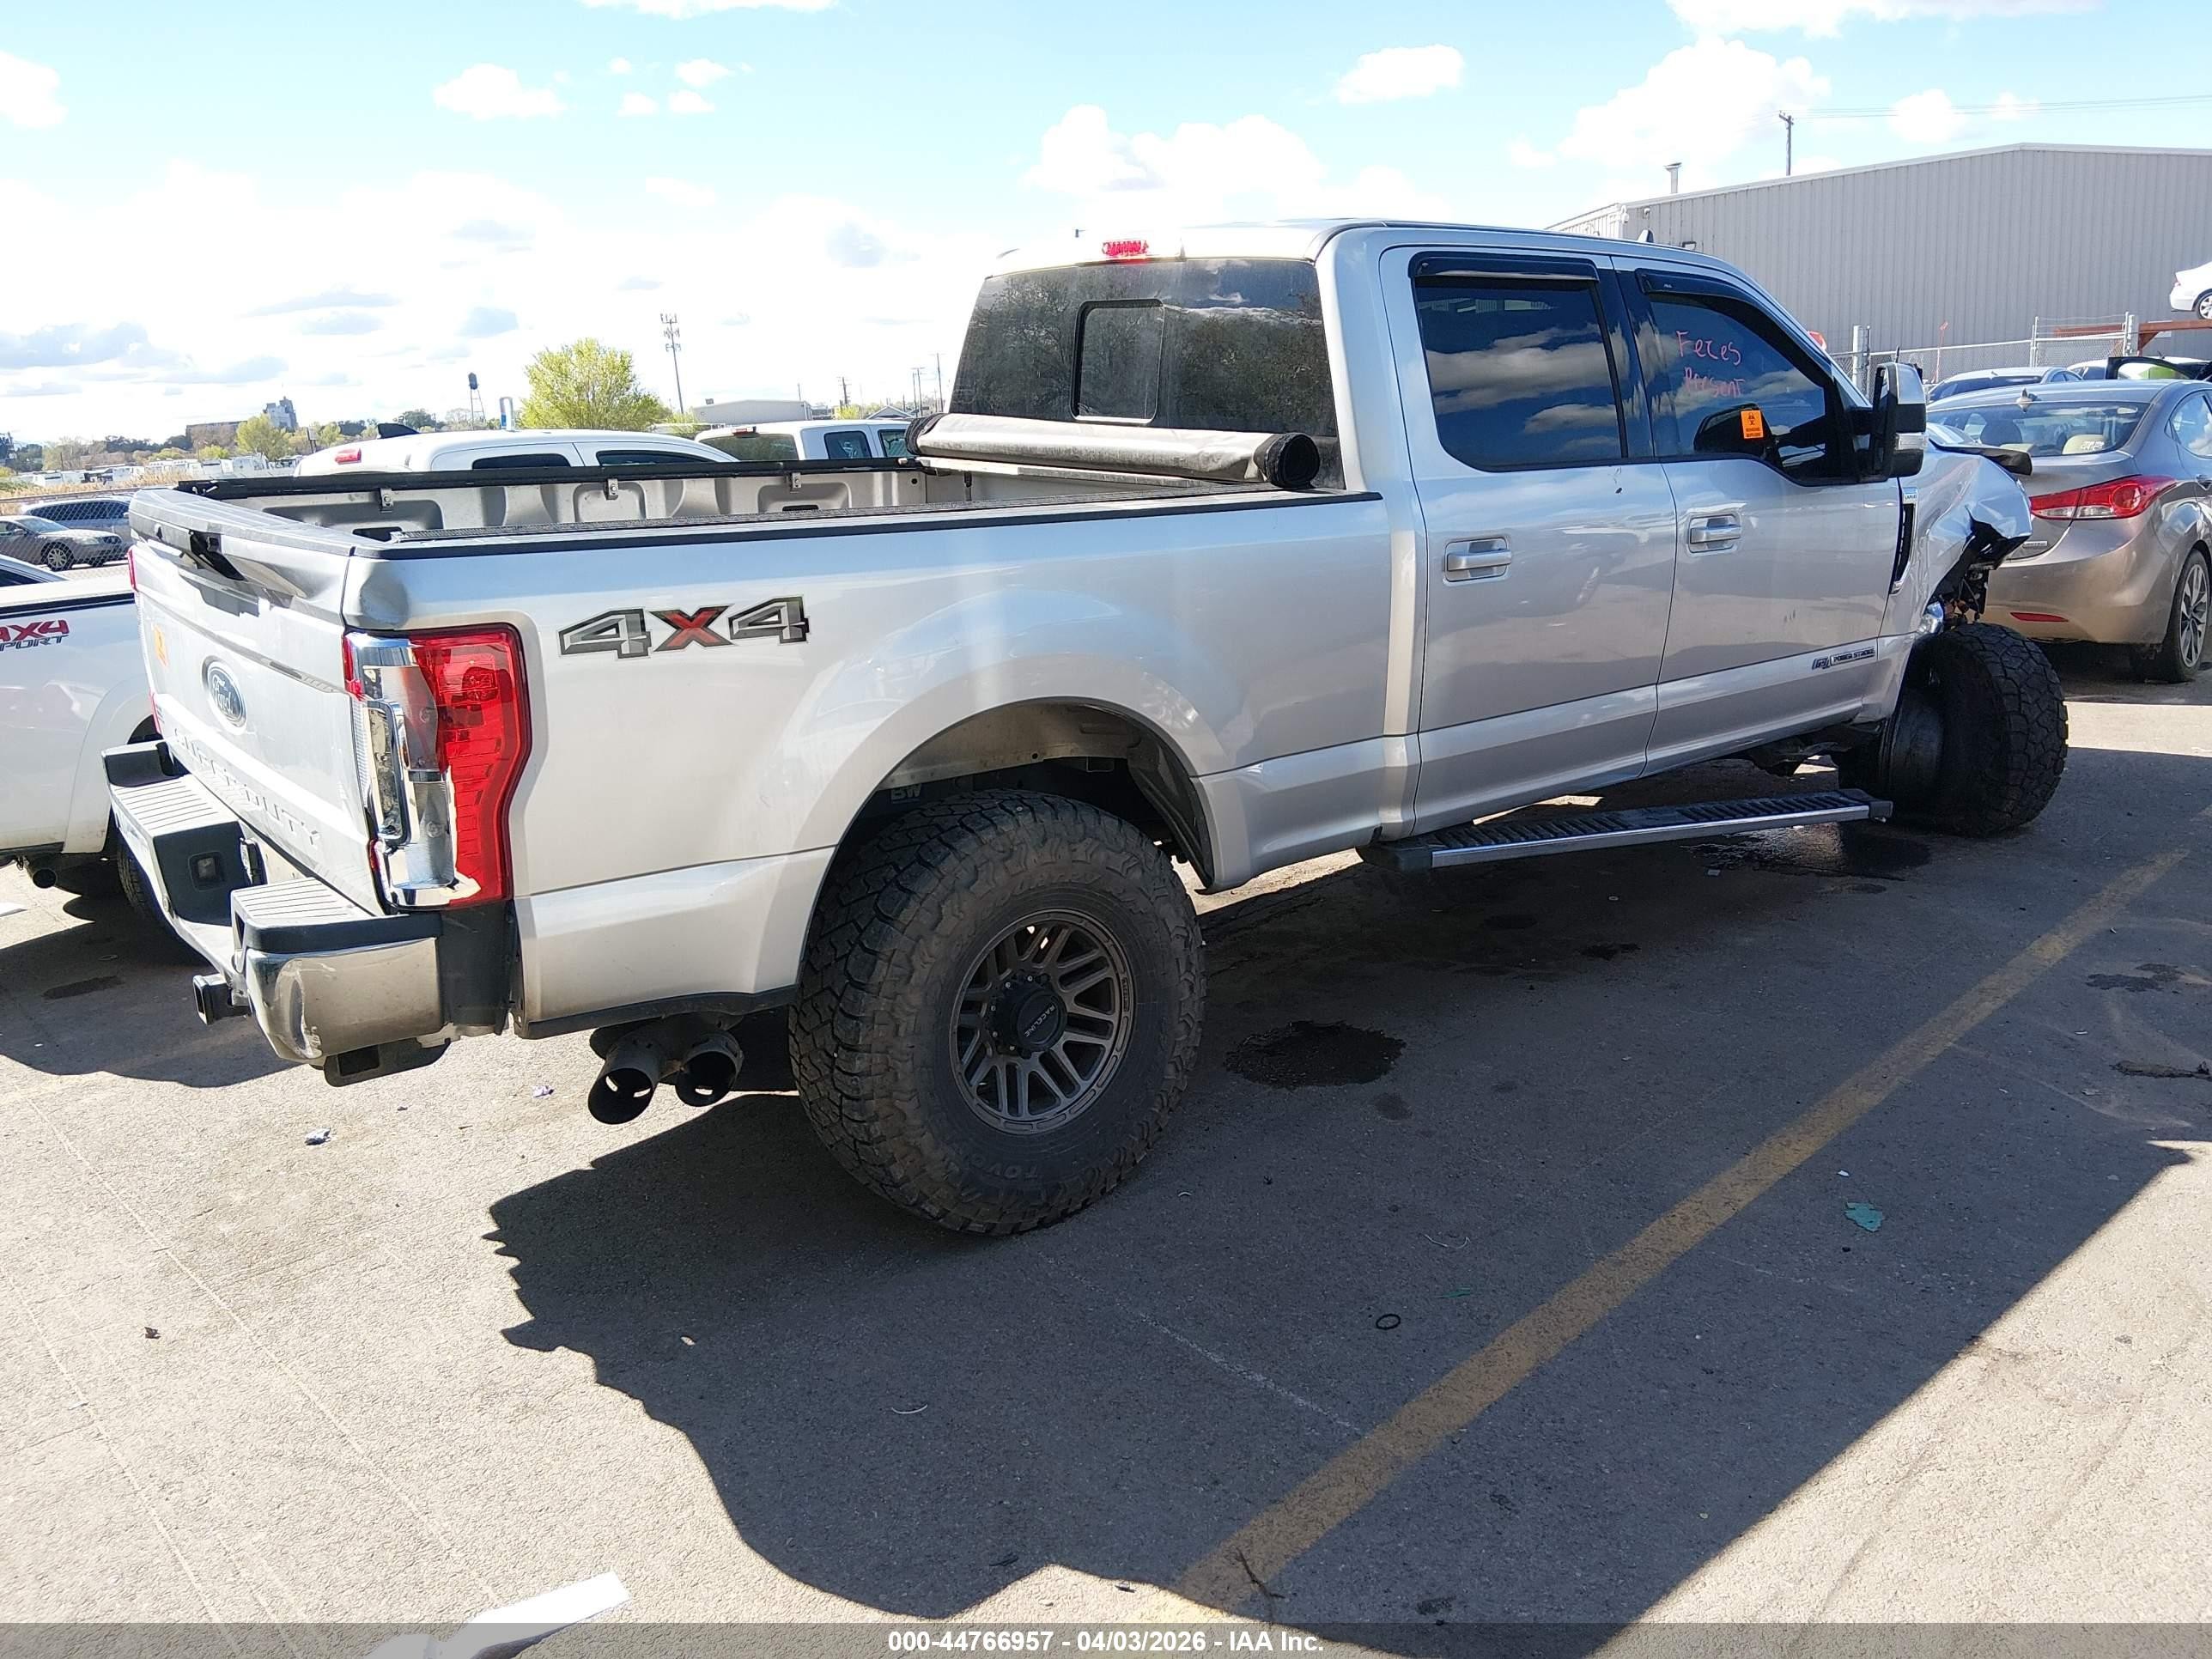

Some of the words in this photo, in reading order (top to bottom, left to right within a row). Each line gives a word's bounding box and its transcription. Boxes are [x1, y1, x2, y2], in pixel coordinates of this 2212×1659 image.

[1675, 330, 1742, 366] Feces
[0, 635, 69, 651] PORT
[1023, 1004, 1056, 1037] RACELINE
